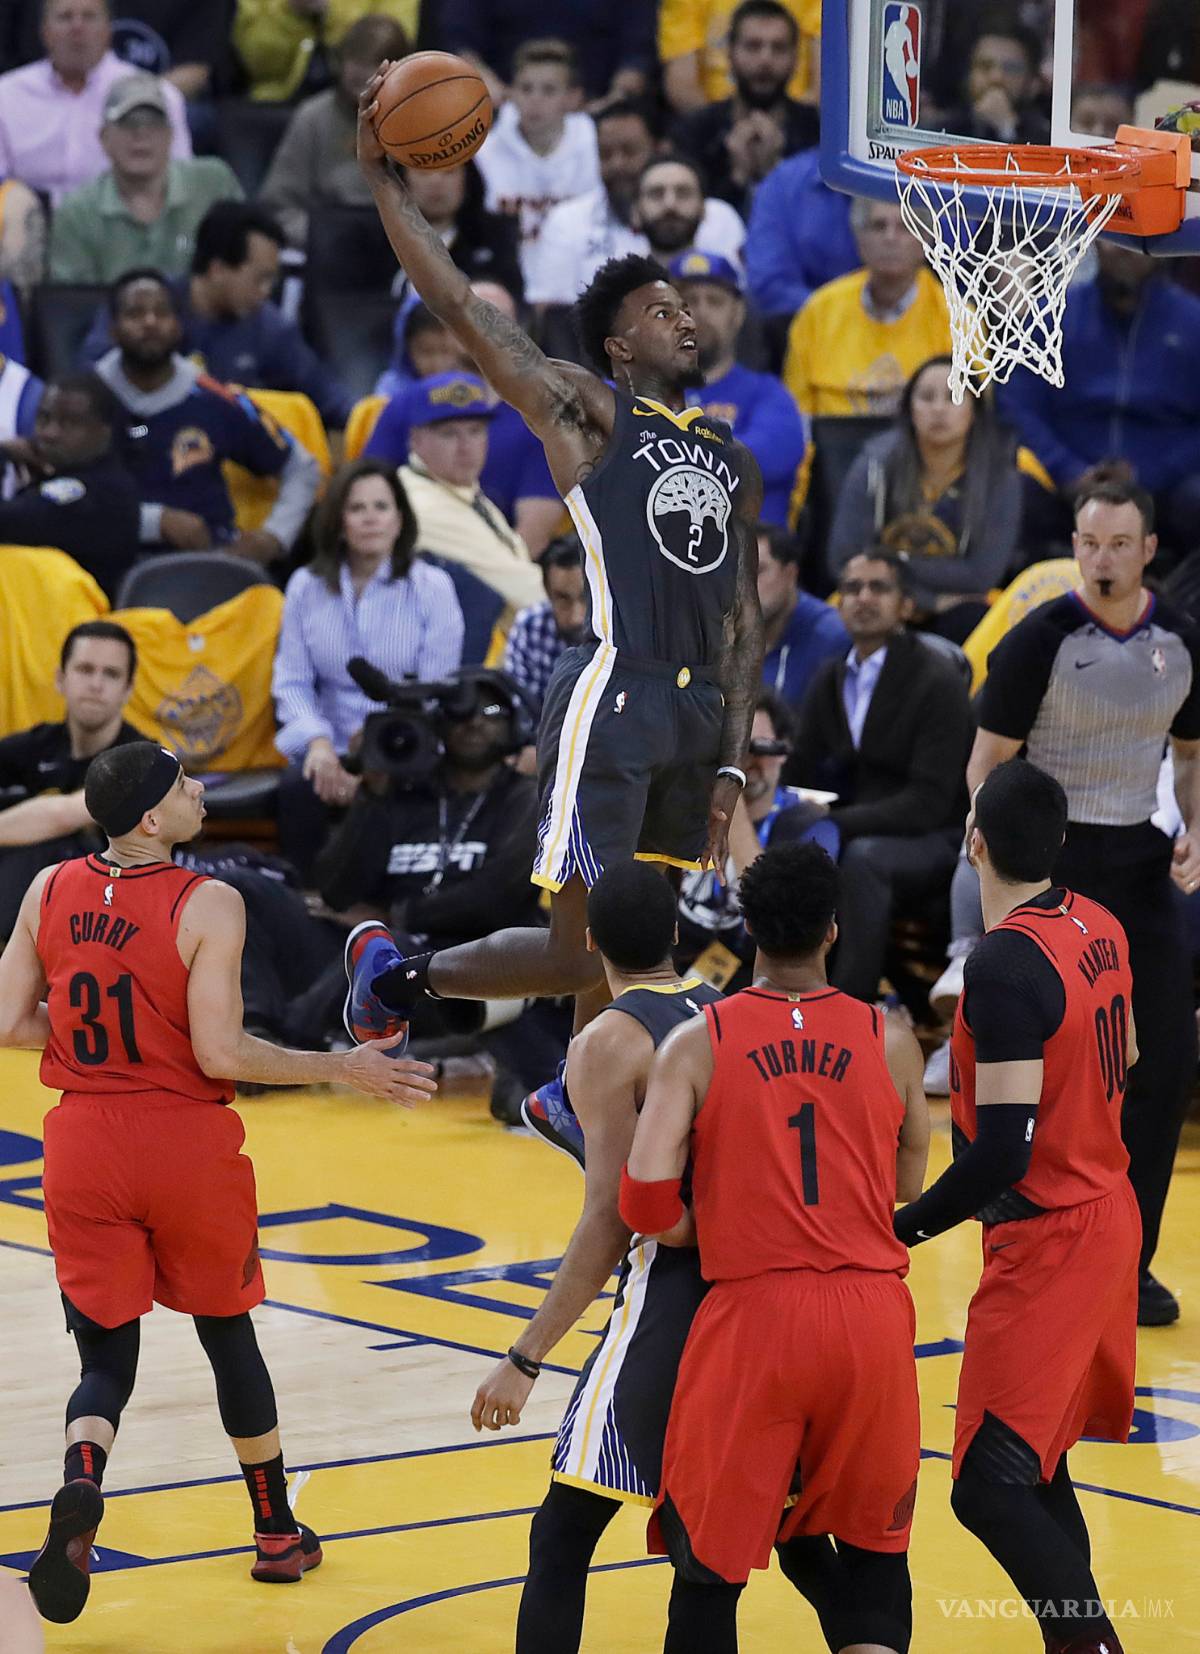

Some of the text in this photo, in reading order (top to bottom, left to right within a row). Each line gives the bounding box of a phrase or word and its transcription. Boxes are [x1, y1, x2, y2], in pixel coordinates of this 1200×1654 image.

[885, 98, 904, 120] NBA
[409, 118, 485, 166] SPALDING
[639, 430, 657, 443] The
[632, 438, 740, 493] TOWN
[687, 524, 703, 562] 2
[70, 911, 140, 951] CURRY
[1078, 938, 1120, 989] KANTER
[69, 971, 143, 1065] 31
[746, 1039, 852, 1082] TURNER
[1095, 994, 1128, 1103] 00
[788, 1102, 819, 1206] 1
